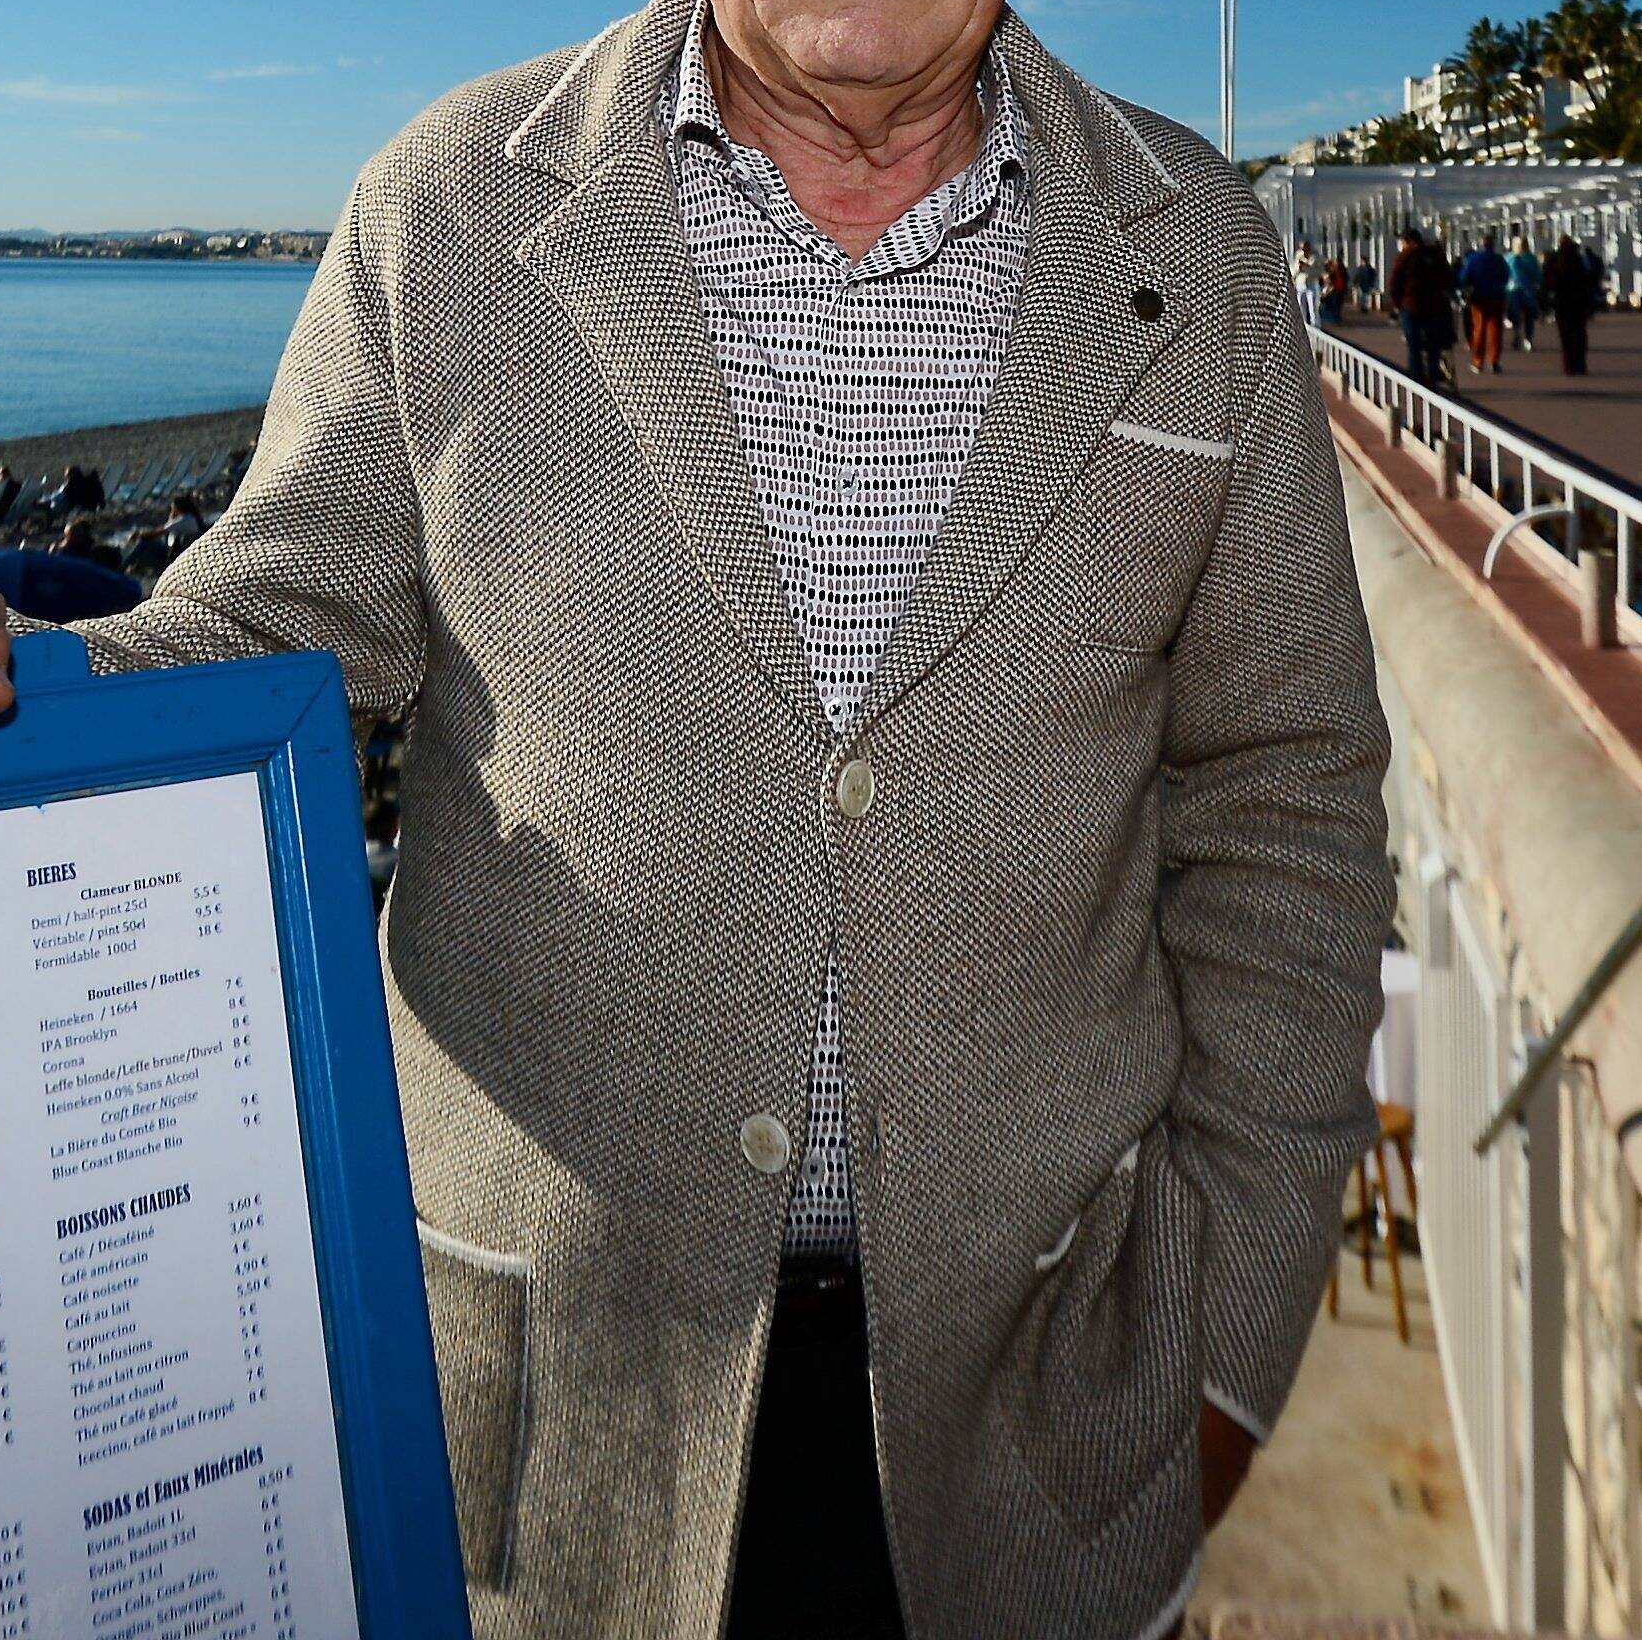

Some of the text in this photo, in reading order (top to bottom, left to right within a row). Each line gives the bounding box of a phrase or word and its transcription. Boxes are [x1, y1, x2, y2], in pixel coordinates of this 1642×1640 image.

[26, 862, 76, 887] BIERES
[80, 871, 182, 900] Clameur BLONDE
[31, 897, 147, 930] Demi half-pint 25cl
[32, 917, 146, 950] Véritable pint 50cl
[34, 939, 136, 971] Formidable 100cl
[87, 969, 200, 1001] Bouteilles Bottles
[39, 1000, 137, 1032] Heineken 1664
[41, 1028, 117, 1053] IPA Brooklyn
[42, 1056, 85, 1074] Corona
[46, 1067, 199, 1116] Heineken 0.0% Sans Alcool
[50, 1116, 177, 1158] La Bière du Comté Bio
[52, 1136, 182, 1180] Blue Coast Blanche Bio
[56, 1182, 191, 1240] BOISSONS CHAUDES
[83, 1493, 131, 1531] SODAS
